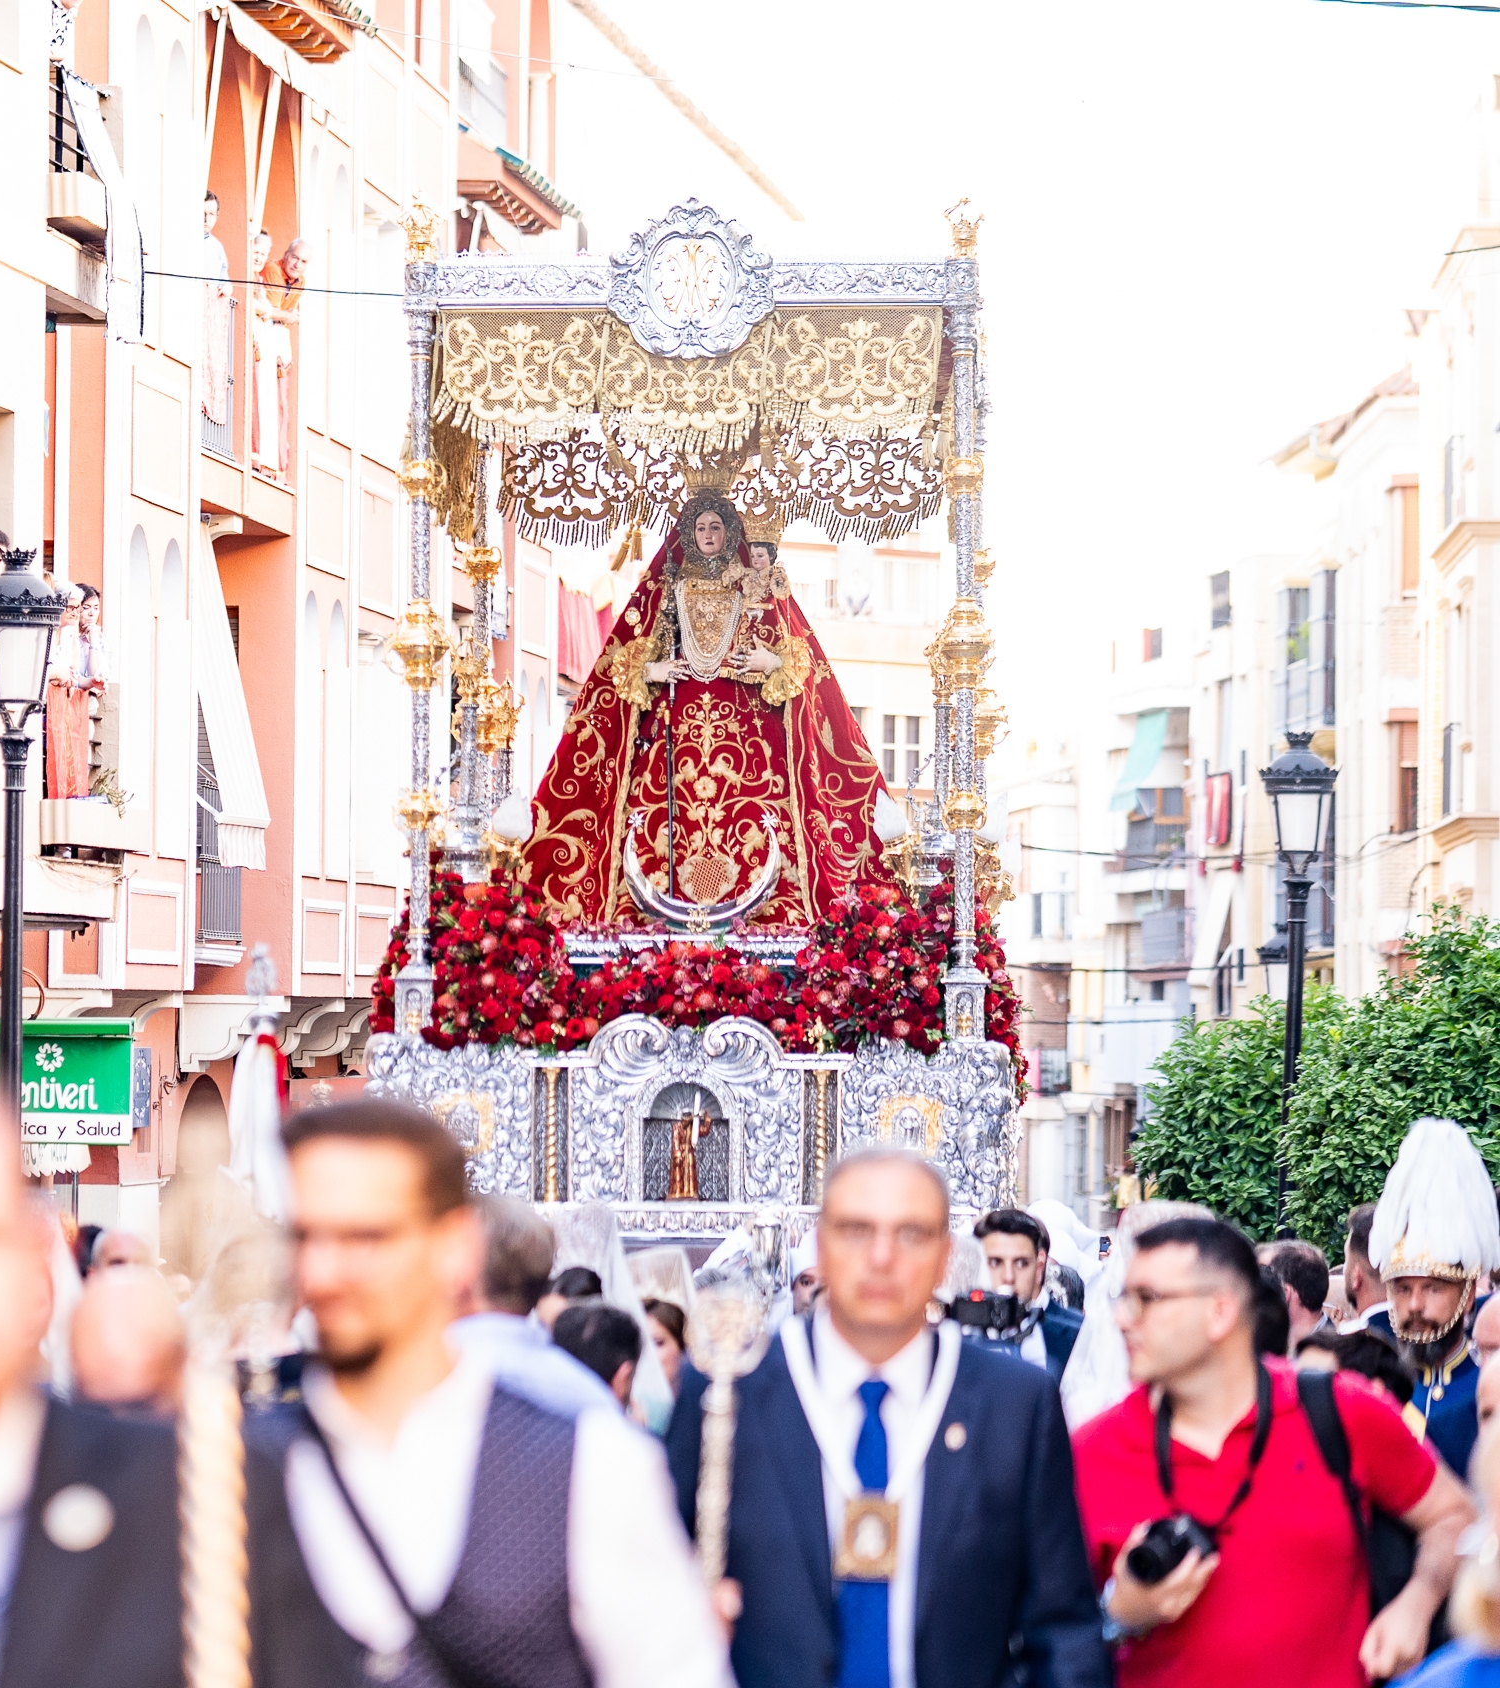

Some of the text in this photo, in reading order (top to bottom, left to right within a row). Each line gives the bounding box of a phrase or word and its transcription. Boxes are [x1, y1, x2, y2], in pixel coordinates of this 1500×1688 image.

[21, 1119, 121, 1139] ica y Salud
